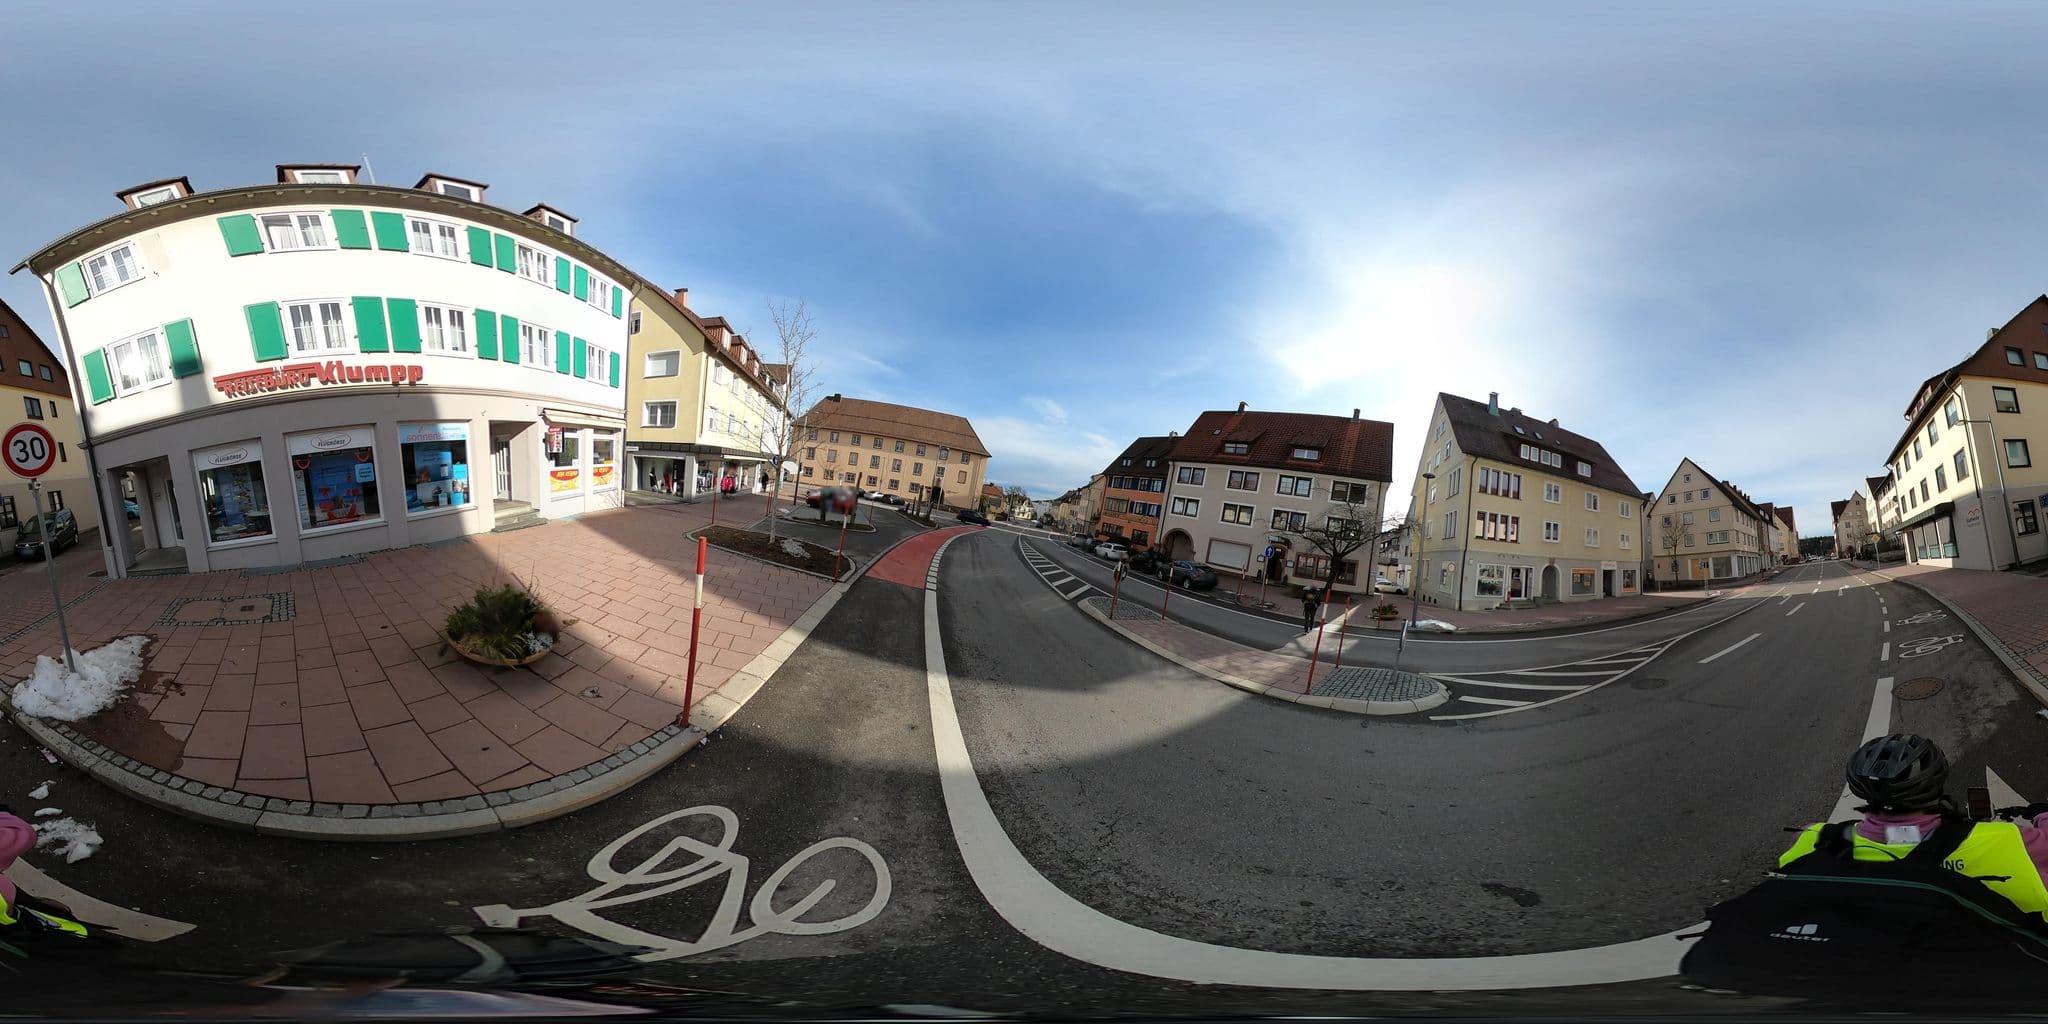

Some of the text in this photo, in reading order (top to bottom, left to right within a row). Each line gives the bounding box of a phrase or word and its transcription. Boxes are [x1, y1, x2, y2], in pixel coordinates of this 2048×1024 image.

[314, 360, 424, 386] Klumpp
[13, 436, 45, 463] 30
[1769, 932, 1829, 942] deuter
